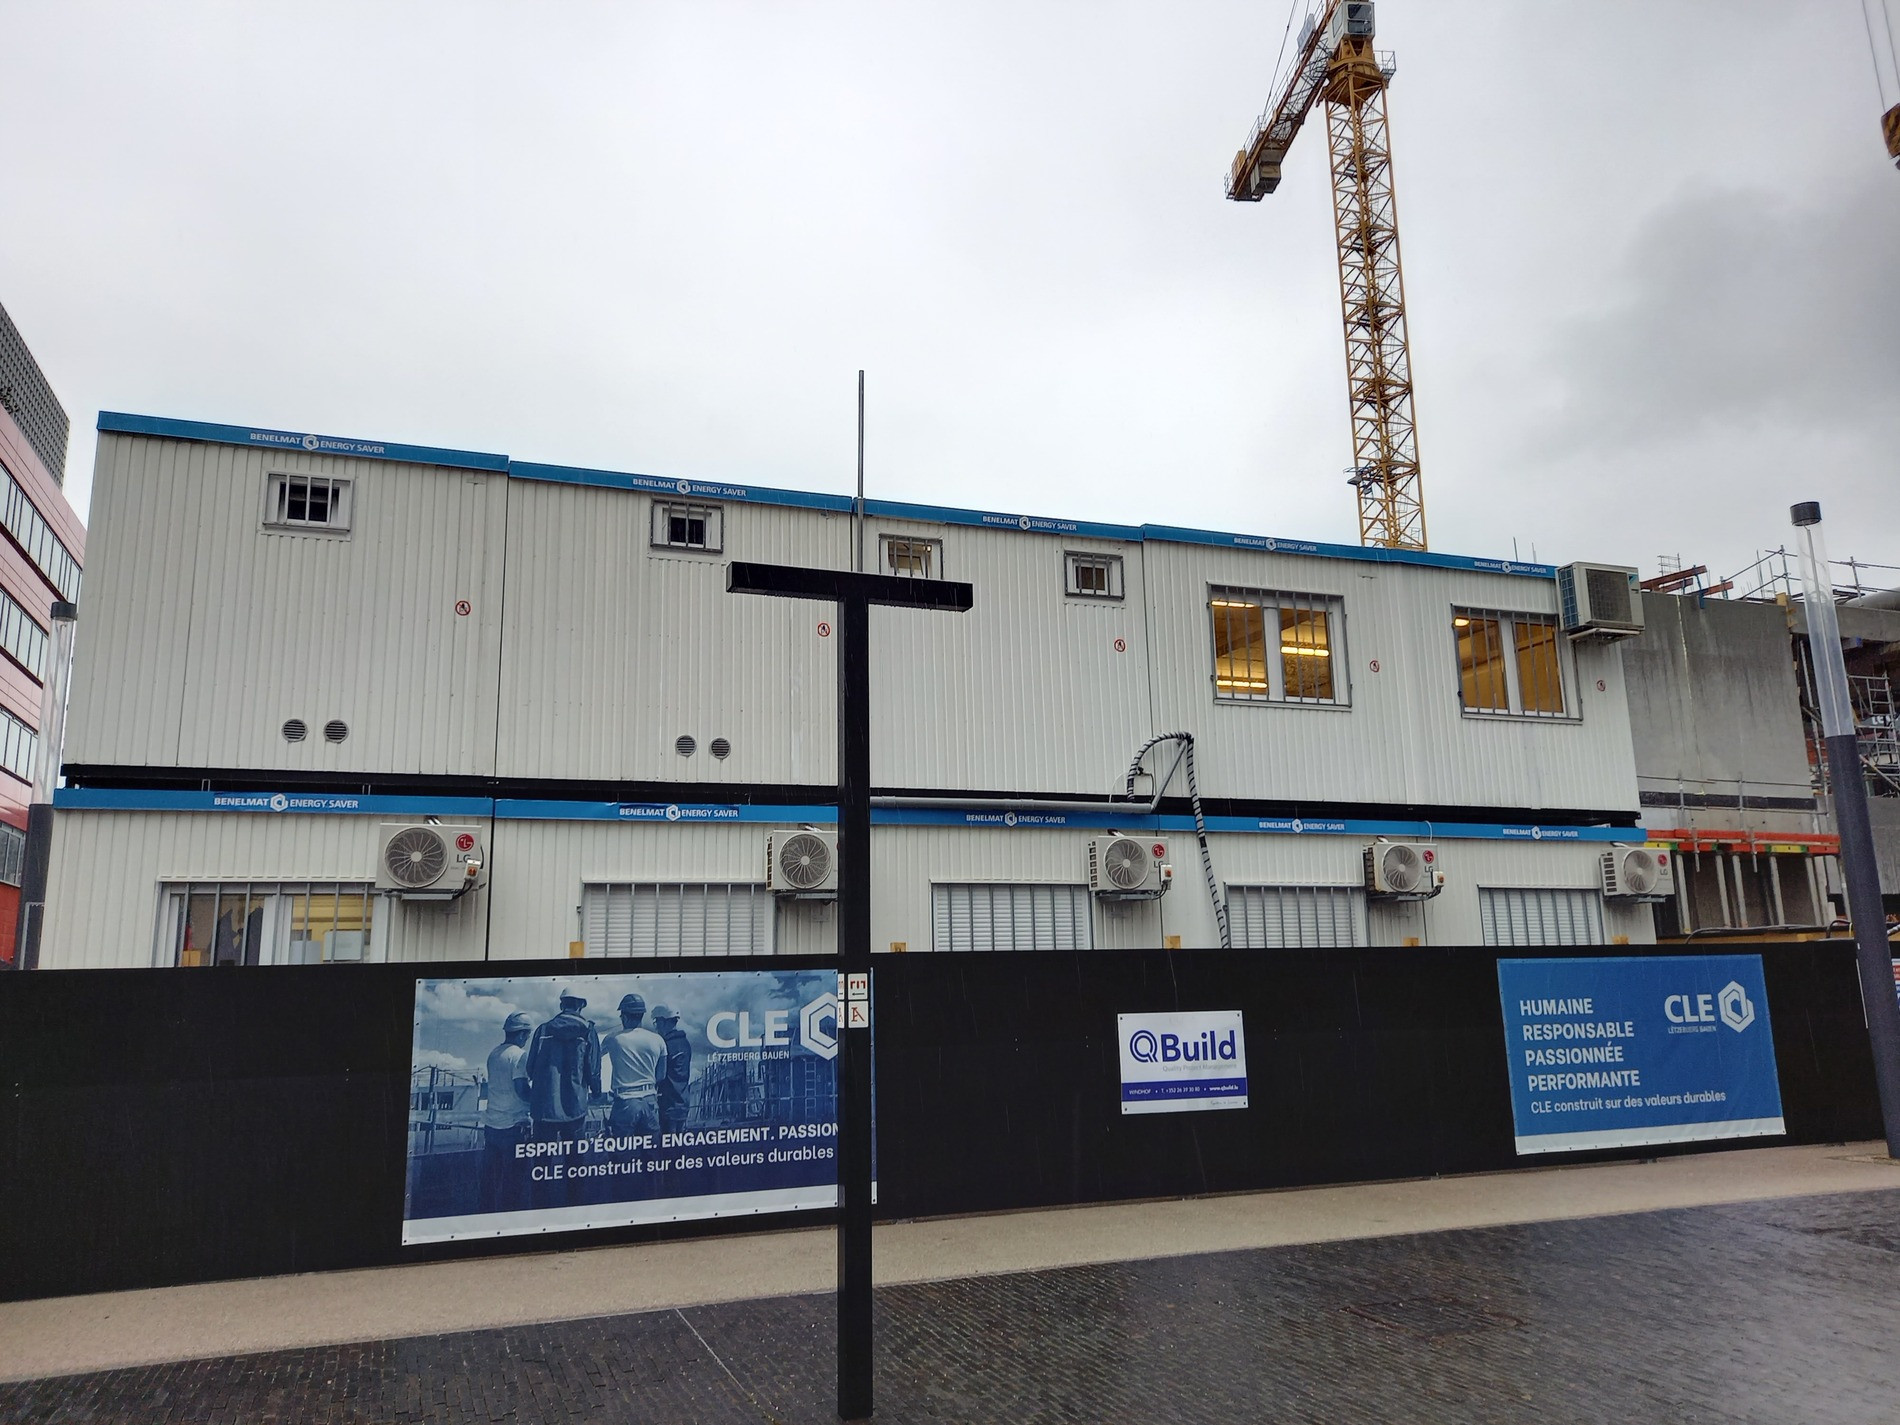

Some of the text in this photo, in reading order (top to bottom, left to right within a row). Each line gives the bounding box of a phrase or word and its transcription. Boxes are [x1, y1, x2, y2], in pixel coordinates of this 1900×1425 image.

[250, 432, 385, 454] BENELMAT ENERGY SAVER
[632, 478, 746, 497] BENELMAT ENERGY SAVER
[982, 515, 1018, 526] BENELMAT
[1031, 521, 1056, 530] ENERGY
[1233, 537, 1317, 552] BENELMAT ENERGY SAVER
[1474, 561, 1502, 569] BENELMAT
[1511, 564, 1531, 572] ENERGY
[214, 797, 359, 809] BENELMAT ENERGY SAVER
[619, 808, 738, 818] BENELMAT ENERGY SAVER
[966, 814, 1003, 822] BENELMAT
[1259, 821, 1291, 829] BENELMAT
[1326, 823, 1345, 831] SAVER
[1502, 828, 1531, 836] BENELMAT
[1520, 998, 1594, 1016] HUMAINE
[1664, 994, 1716, 1024] CLE
[706, 1009, 790, 1049] CLE
[1523, 1021, 1635, 1041] RESPONSABLE
[762, 1051, 790, 1060] BAUEN
[1525, 1041, 1624, 1067] PASSIONNÉE
[1527, 1069, 1641, 1092] PERFORMANTE
[1530, 1091, 1727, 1114] CLE construit sur des valeurs durables
[515, 1141, 574, 1159] ESPRIT
[661, 1126, 775, 1149] ENGAGEMENT.
[531, 1145, 834, 1181] CLE construit sur des valeurs durables
